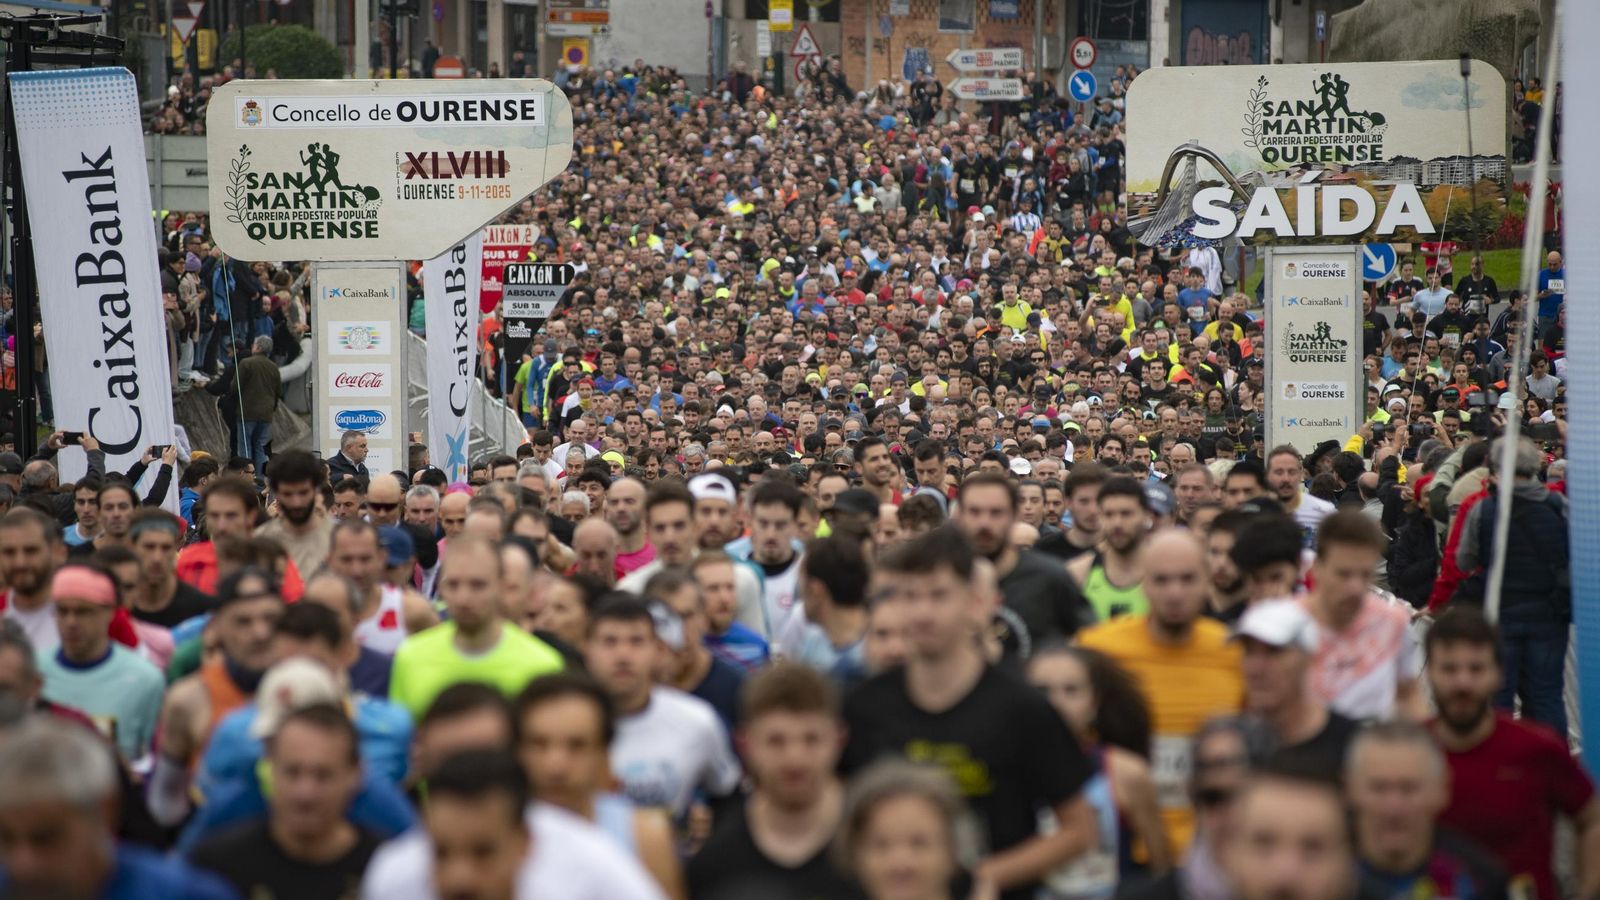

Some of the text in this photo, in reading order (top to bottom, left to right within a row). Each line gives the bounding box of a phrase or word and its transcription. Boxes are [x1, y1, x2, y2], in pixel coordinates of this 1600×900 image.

[272, 99, 536, 122] Concello de OURENSE
[1262, 100, 1315, 117] SAN
[1262, 117, 1366, 135] MARTIN
[1262, 134, 1383, 146] CARREIRA PEDESTRE POPULAR
[1262, 144, 1383, 163] OURENSE
[404, 150, 506, 180] XLVIII
[246, 171, 303, 190] SAN
[403, 184, 511, 200] OURENSE 9-11-2025
[246, 191, 359, 210] MARTIN
[1192, 171, 1436, 240] SAÍDA
[247, 209, 378, 221] CARREIRA PEDESTRE POPULAR
[247, 220, 379, 241] OURENSE
[525, 227, 532, 243] 2
[483, 249, 519, 259] SUB 16
[559, 265, 566, 285] 1
[1302, 269, 1346, 278] OURENSE
[342, 287, 389, 298] CaixaBank
[507, 289, 556, 297] ABSOLUTA
[62, 144, 143, 456] CaixaBank
[512, 302, 530, 310] SUB
[1300, 296, 1343, 306] CaixaBank
[444, 241, 468, 418] CaixaBa
[1290, 333, 1315, 341] SAN
[1290, 342, 1339, 350] MARTIN
[1289, 354, 1347, 363] OURENSE
[1301, 390, 1345, 399] OURENSE
[338, 413, 381, 425] aquaBona
[1299, 417, 1343, 427] CaixaBank
